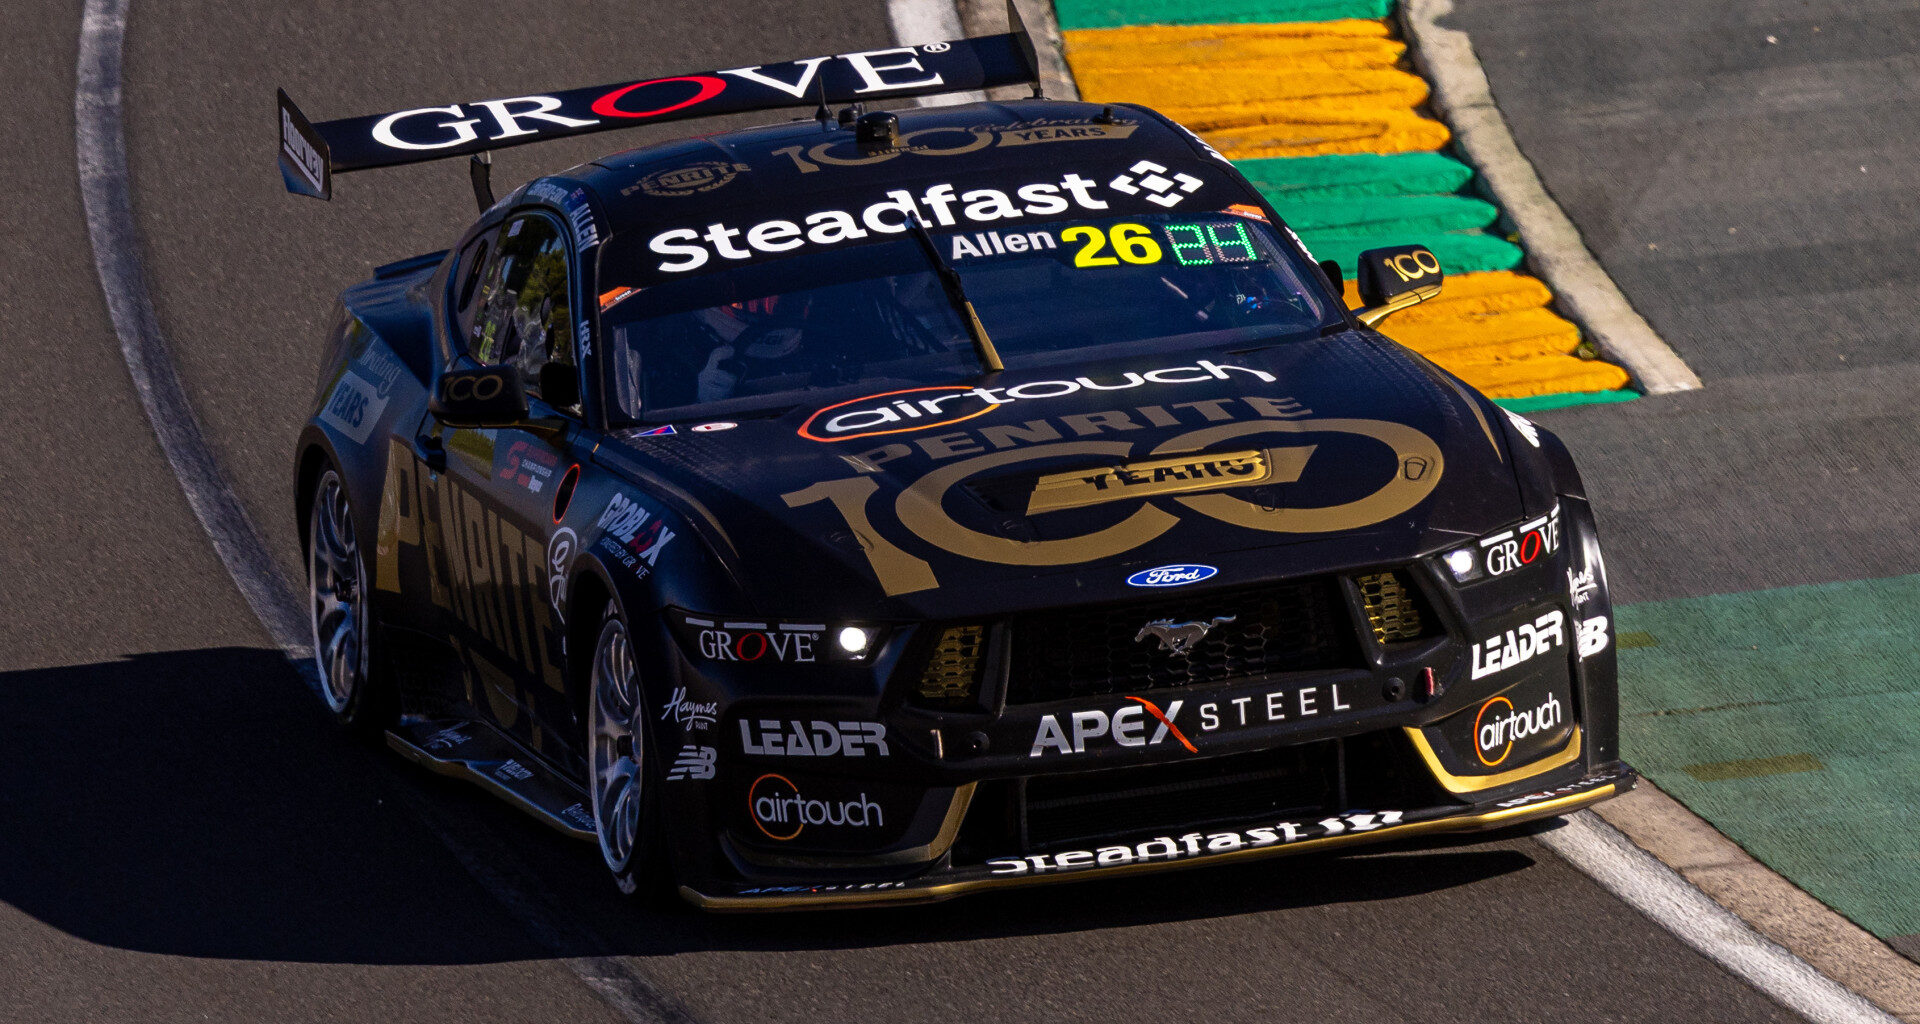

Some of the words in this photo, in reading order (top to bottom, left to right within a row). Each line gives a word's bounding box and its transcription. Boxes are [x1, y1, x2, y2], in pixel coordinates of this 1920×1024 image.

[1015, 125, 1107, 142] YEARS
[620, 163, 752, 197] PENRITE
[569, 202, 600, 253] ALLEN
[648, 173, 1108, 273] Steadfast
[951, 230, 1057, 261] Allen
[1061, 223, 1162, 268] 26
[825, 358, 1277, 442] airtouch
[850, 395, 1316, 476] PENRITE
[1085, 448, 1266, 492] YEARS
[1486, 516, 1560, 577] GROVE
[1147, 568, 1202, 585] Ford
[1471, 609, 1564, 681] LEADER
[660, 686, 718, 732] Haymes
[1030, 696, 1199, 757] APEX
[1200, 683, 1351, 732] STEEL
[1480, 691, 1561, 752] airtouch
[738, 718, 890, 757] LEADER
[755, 792, 884, 827] airtouch
[986, 822, 1308, 874] Steadfast
